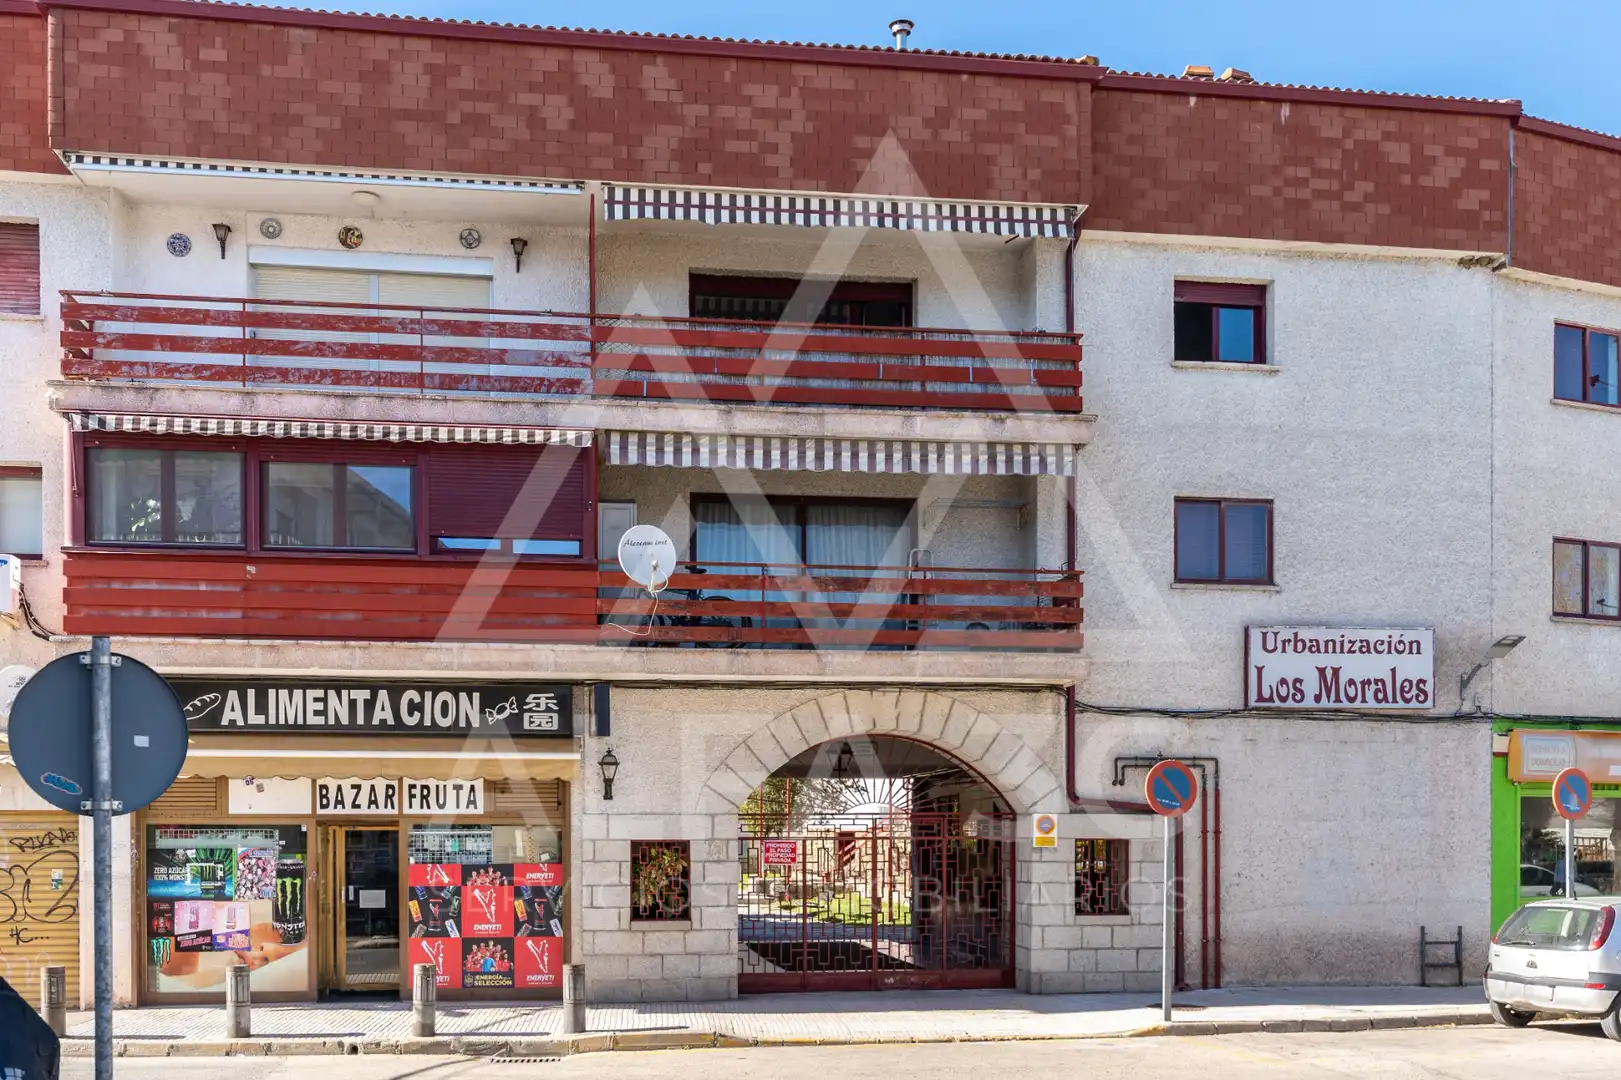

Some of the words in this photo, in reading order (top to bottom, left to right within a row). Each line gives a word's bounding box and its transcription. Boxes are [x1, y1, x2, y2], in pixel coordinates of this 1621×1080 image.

[1261, 631, 1422, 655] Urbanización
[1254, 665, 1306, 704] Los
[1313, 665, 1430, 704] Morales
[318, 784, 396, 810] BAZAR
[407, 784, 478, 810] FRUTA
